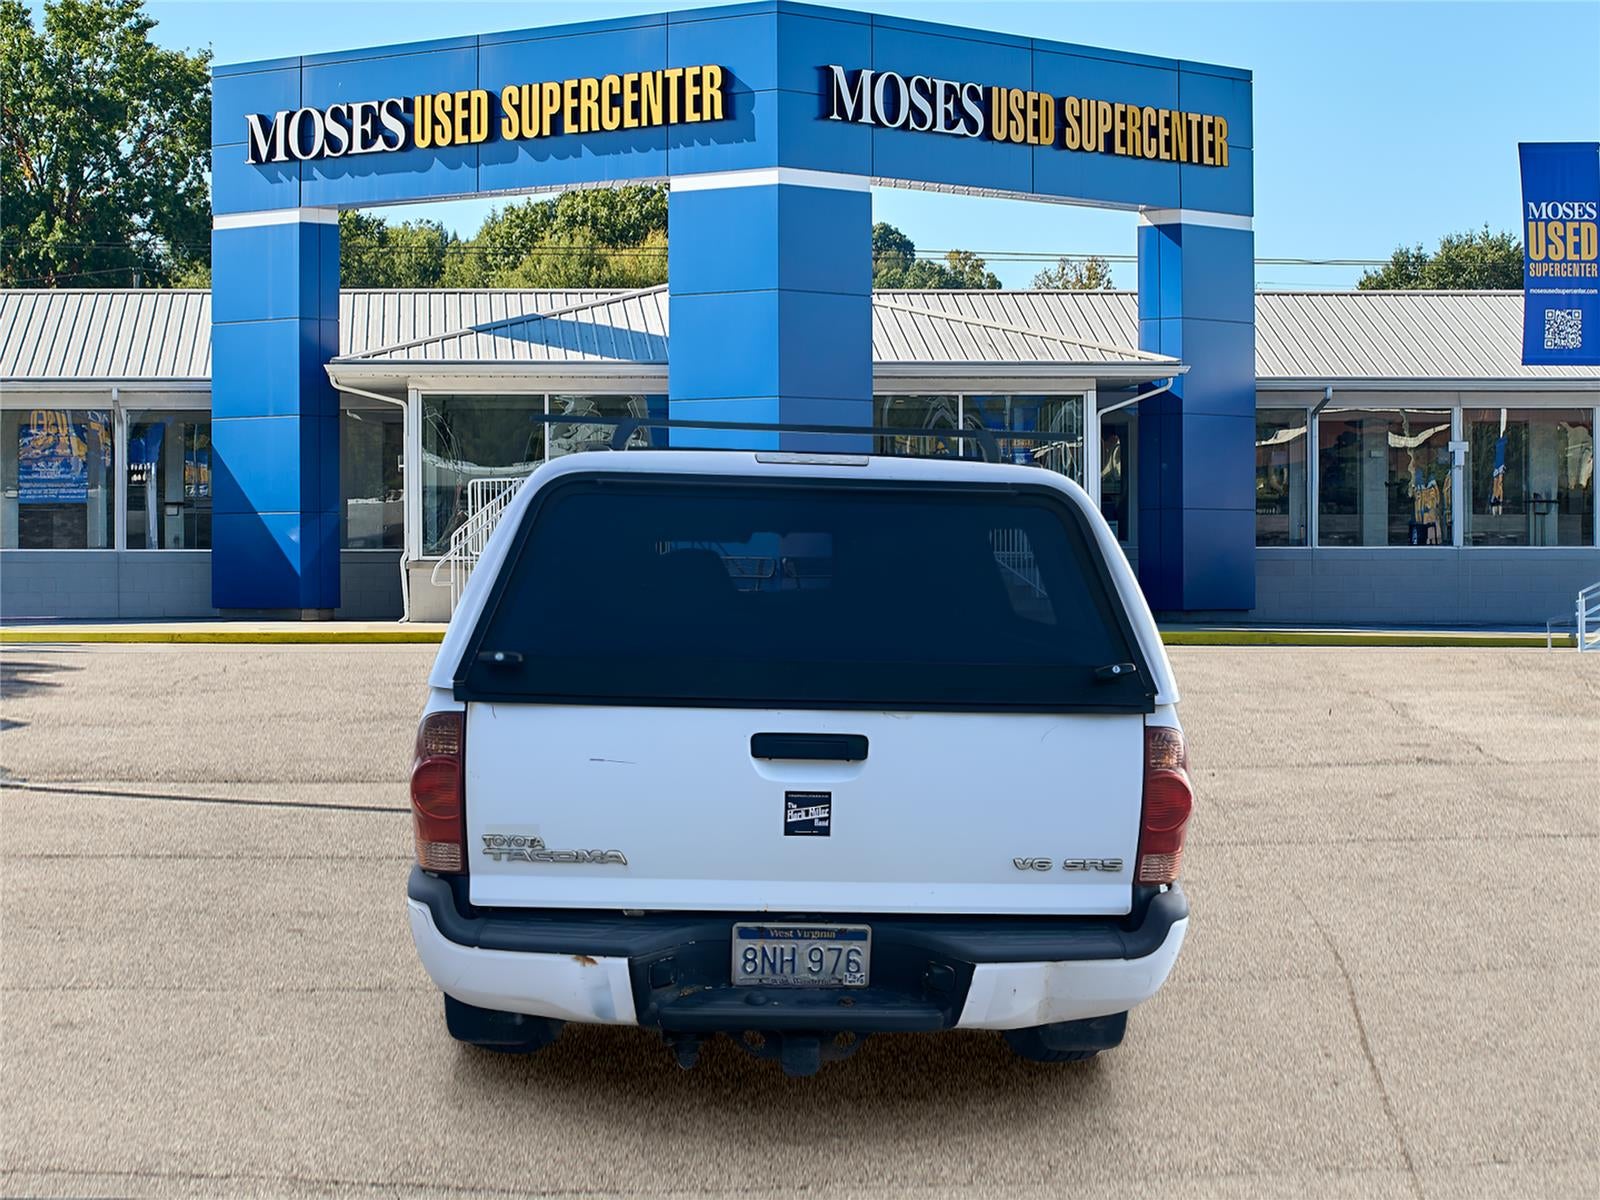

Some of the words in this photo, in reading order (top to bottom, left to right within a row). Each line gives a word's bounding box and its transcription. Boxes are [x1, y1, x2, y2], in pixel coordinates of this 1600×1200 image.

[245, 98, 406, 165] MOSES
[414, 89, 489, 149] USED
[501, 64, 724, 141] SUPERCENTER
[829, 64, 984, 138] MOSES
[991, 86, 1055, 146] USED
[1065, 96, 1229, 167] SUPERCENTER
[1528, 201, 1597, 220] MOSES
[1528, 221, 1598, 261] USED
[1529, 262, 1598, 278] SUPERCENTER
[482, 834, 545, 848] TOYOTA
[482, 848, 628, 865] TACOMA
[1013, 858, 1052, 871] V6
[769, 929, 794, 938] West
[797, 929, 836, 939] Virginia
[742, 945, 797, 975] 8NH
[807, 945, 863, 976] 976
